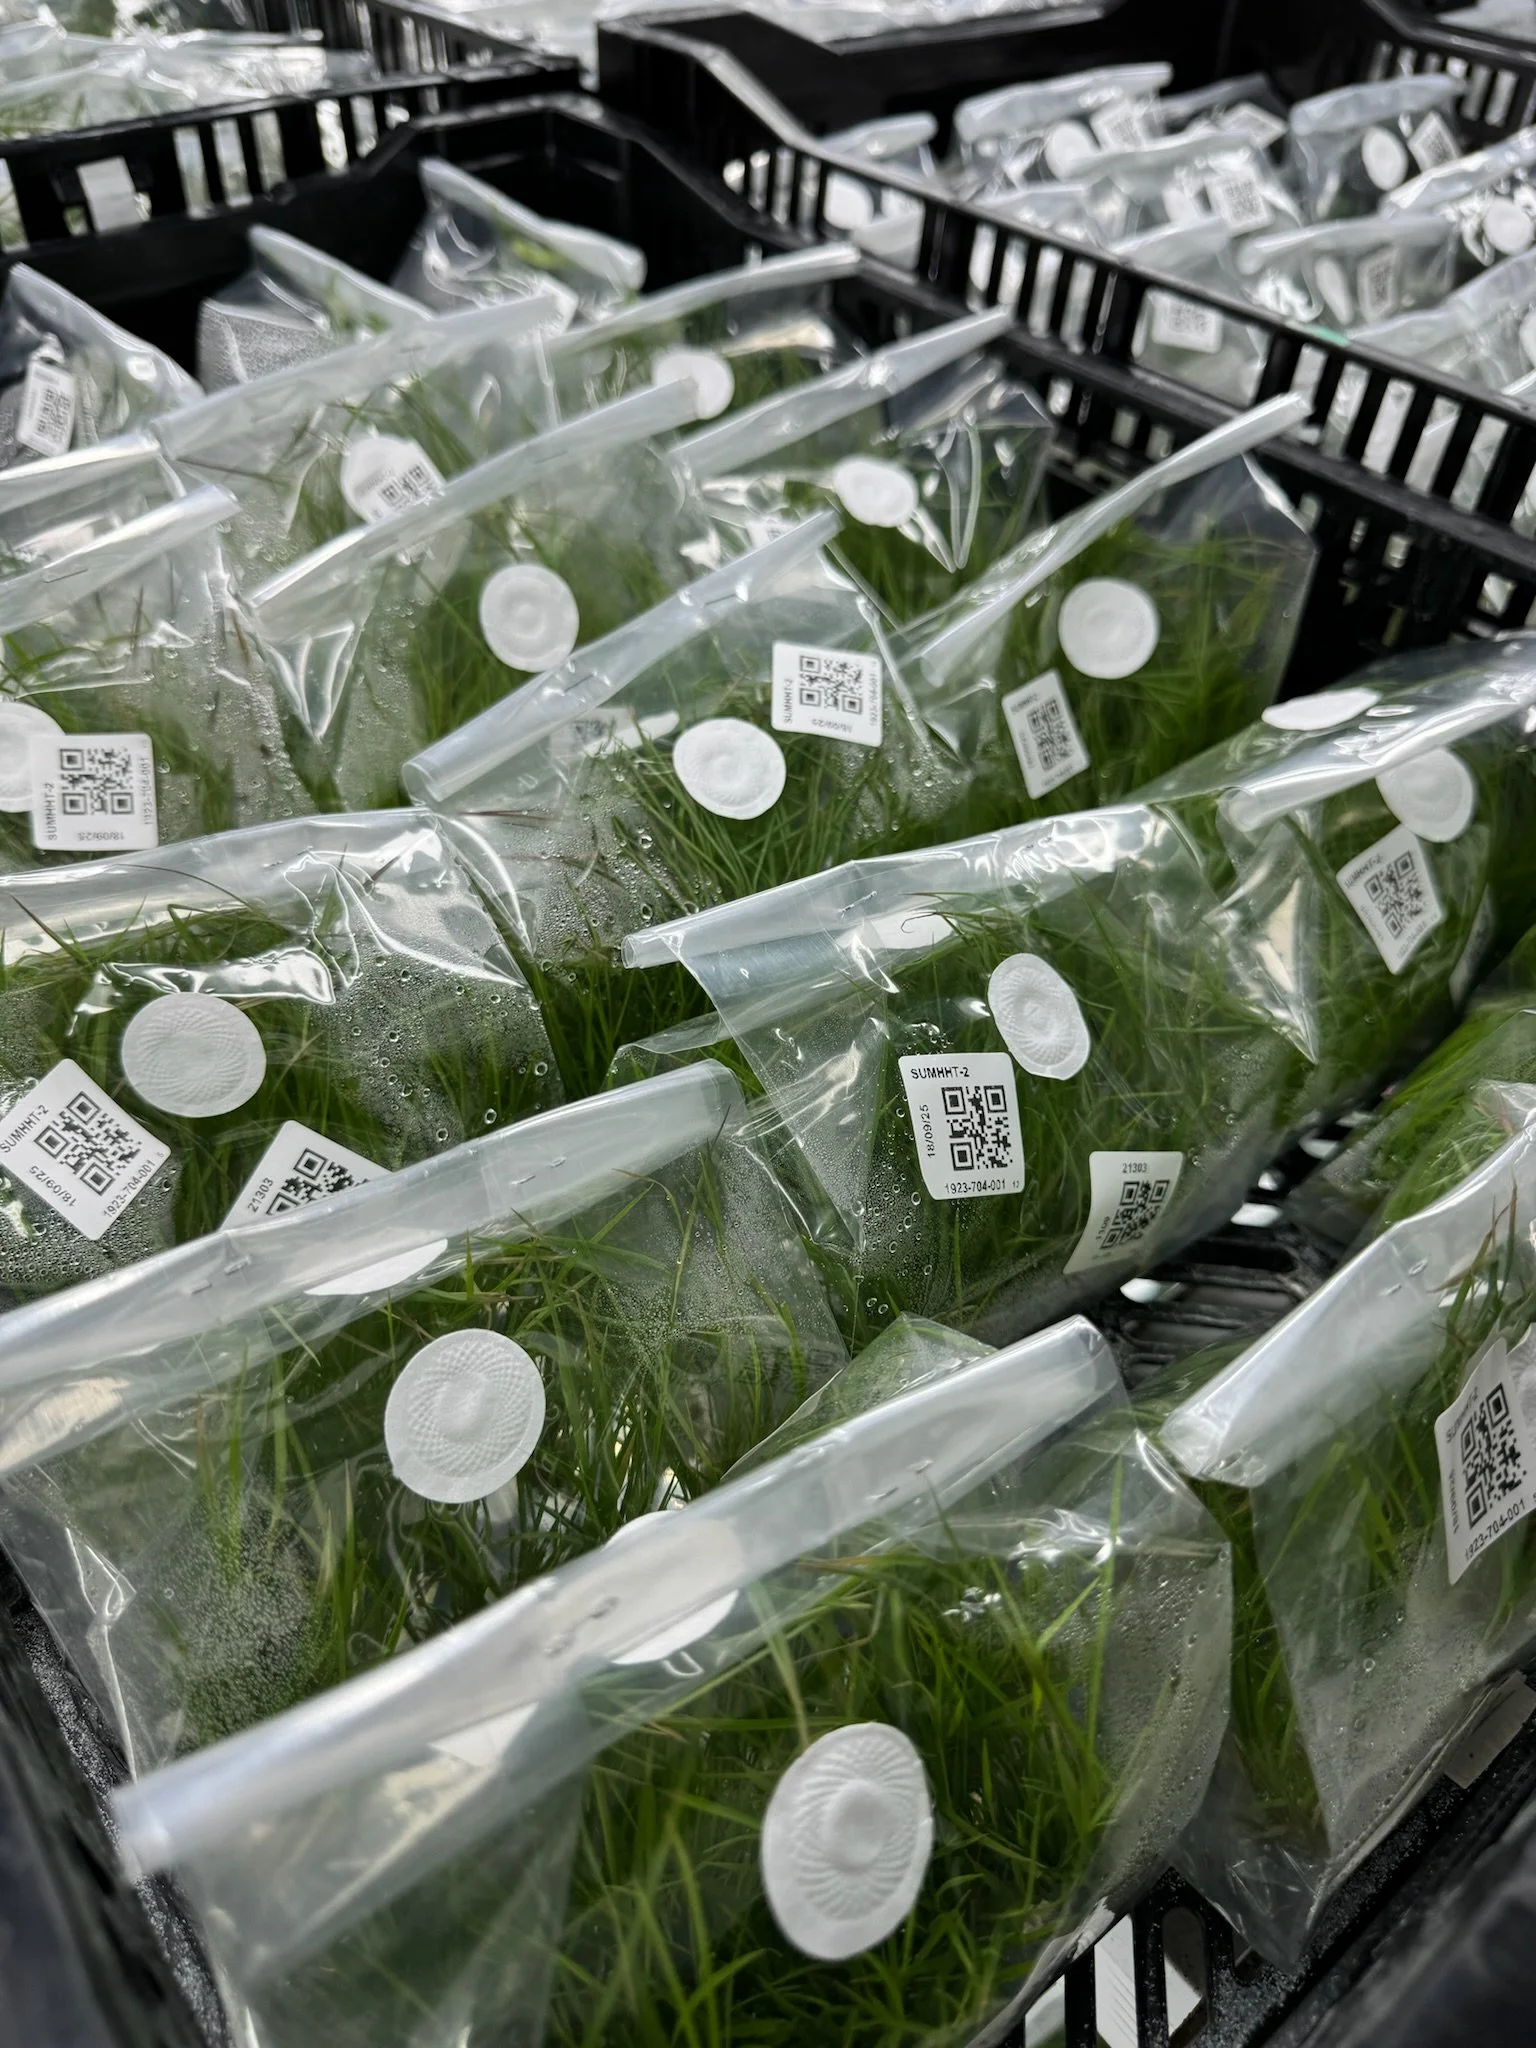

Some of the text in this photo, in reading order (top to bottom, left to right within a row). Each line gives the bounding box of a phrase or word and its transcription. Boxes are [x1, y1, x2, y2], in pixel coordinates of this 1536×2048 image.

[43, 782, 57, 841] SUMHHT-2
[911, 1066, 970, 1080] SUMHHT-2
[0, 1104, 49, 1153] SUMHHT-2
[919, 1104, 936, 1158] 18/09/25
[29, 1165, 77, 1208] 18/09/25
[103, 1159, 156, 1218] 1923-704-001
[944, 1179, 1006, 1194] 1923-704-001
[1122, 1162, 1148, 1174] 21303
[247, 1177, 274, 1213] 21303
[1464, 1498, 1526, 1562] 1923-704-001
